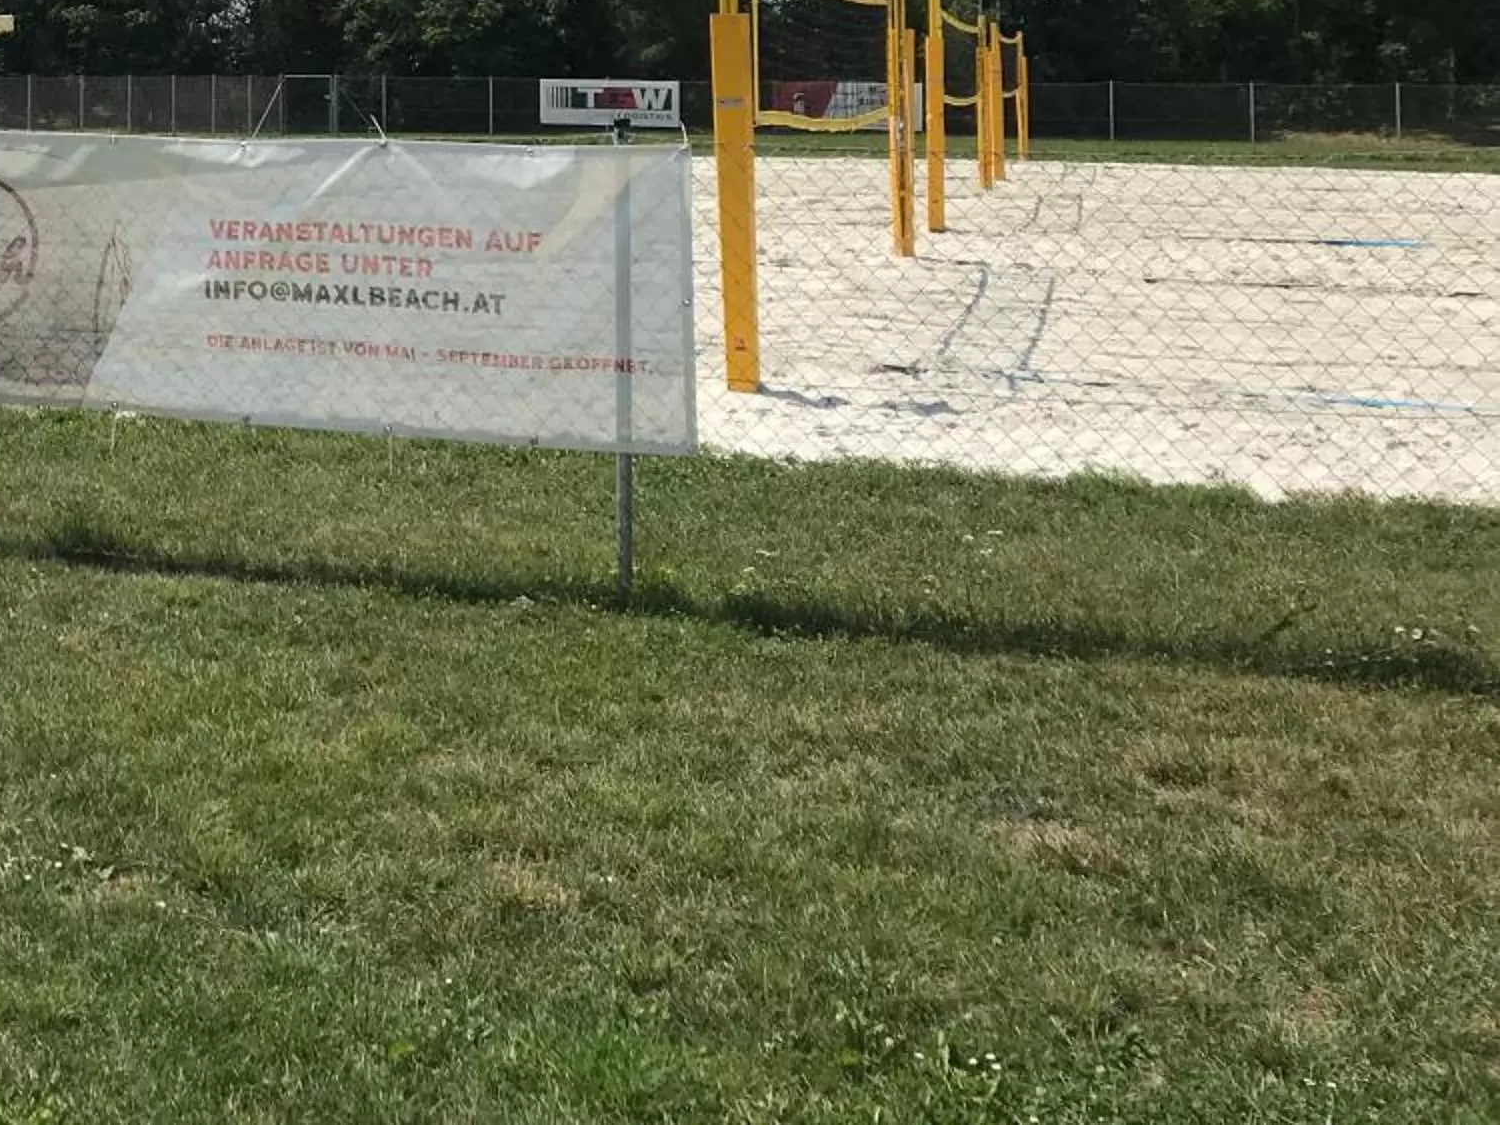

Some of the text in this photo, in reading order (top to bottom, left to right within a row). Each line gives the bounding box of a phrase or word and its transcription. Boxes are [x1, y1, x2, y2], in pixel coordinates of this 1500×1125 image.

[209, 219, 543, 252] VERANSTALTUNGEN AUF
[206, 250, 433, 278] ANFRAGE UNTER
[205, 280, 507, 315] INFO@MAXLBEACH.AT
[206, 334, 232, 348] DIE
[238, 335, 304, 354] ANLAGE
[311, 338, 336, 356] IST
[343, 341, 379, 358] VON
[436, 348, 544, 370] SEPTEMBER
